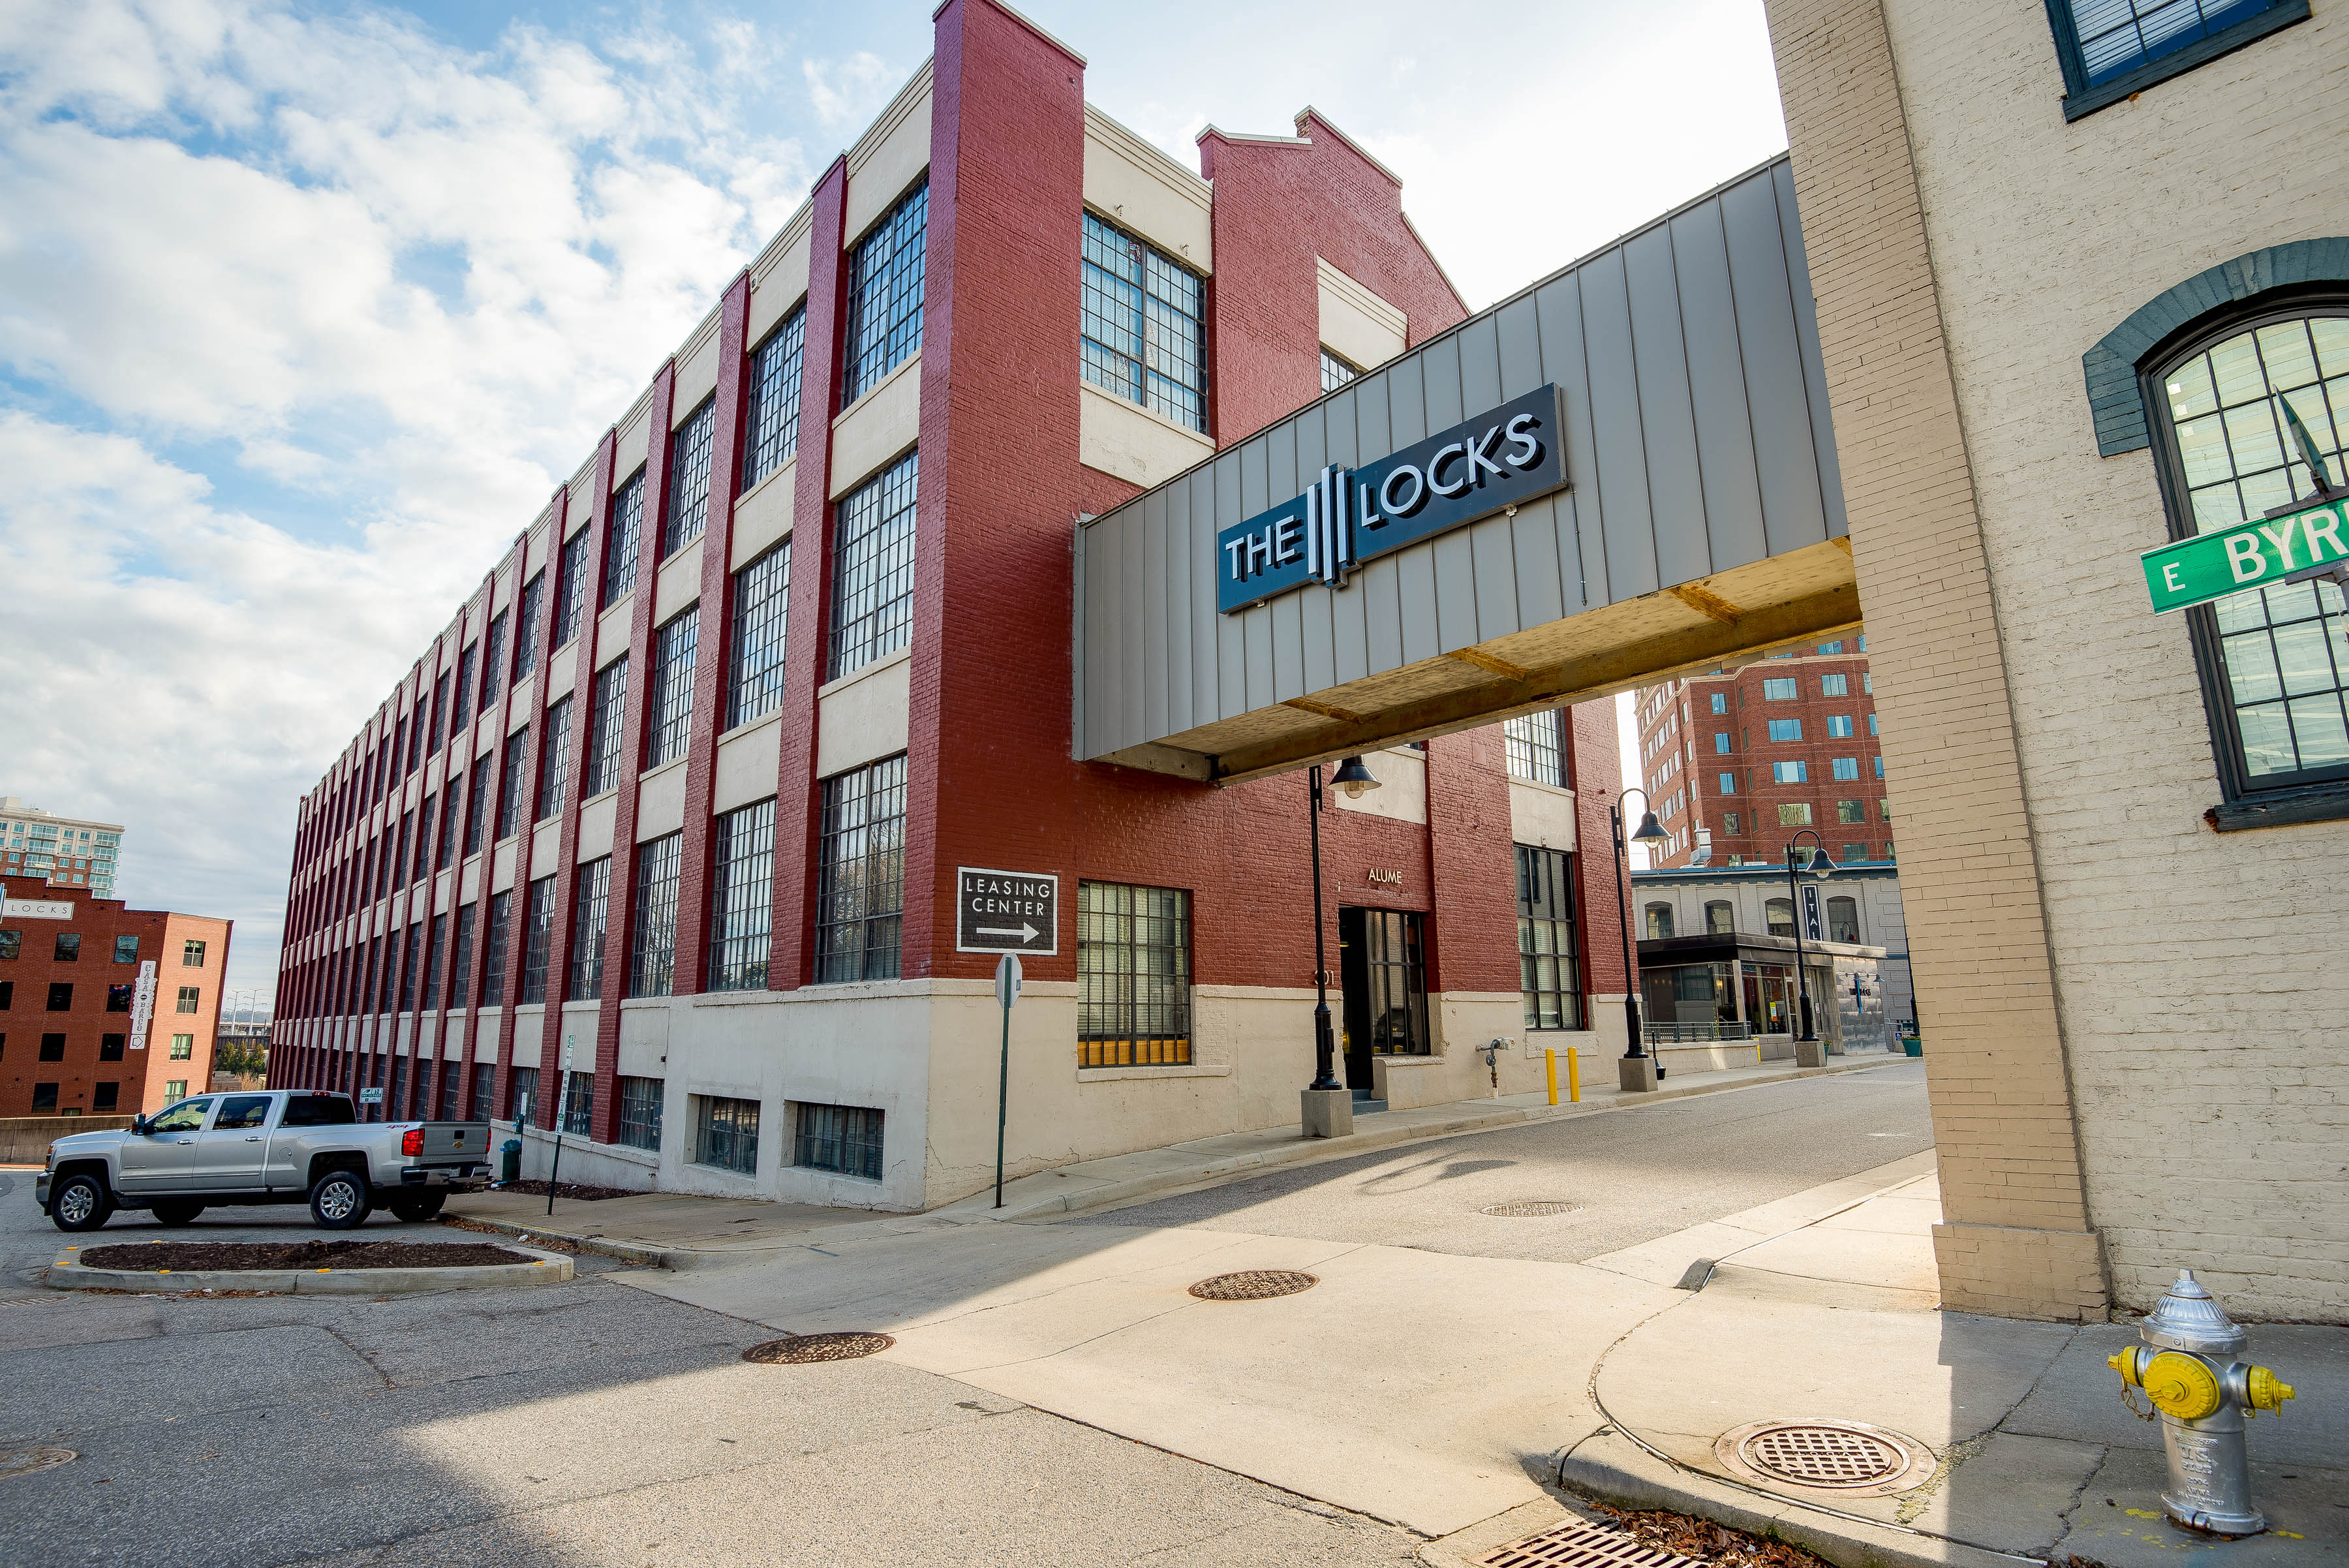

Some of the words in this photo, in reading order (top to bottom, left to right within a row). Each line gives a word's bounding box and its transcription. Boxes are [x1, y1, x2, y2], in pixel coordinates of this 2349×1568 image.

[1225, 514, 1297, 579] THE
[1360, 413, 1538, 527] LOCKS
[2162, 562, 2186, 592] E
[2223, 502, 2349, 584] BYR
[966, 878, 1050, 898] LEASING
[1368, 868, 1402, 884] ALUME
[11, 904, 68, 914] LOCKS
[972, 898, 1044, 915] CENTER
[1808, 889, 1818, 940] ITAL
[142, 964, 151, 992] CASA
[136, 1002, 146, 1032] BARCO
[2181, 1460, 2213, 1475] PIPE
